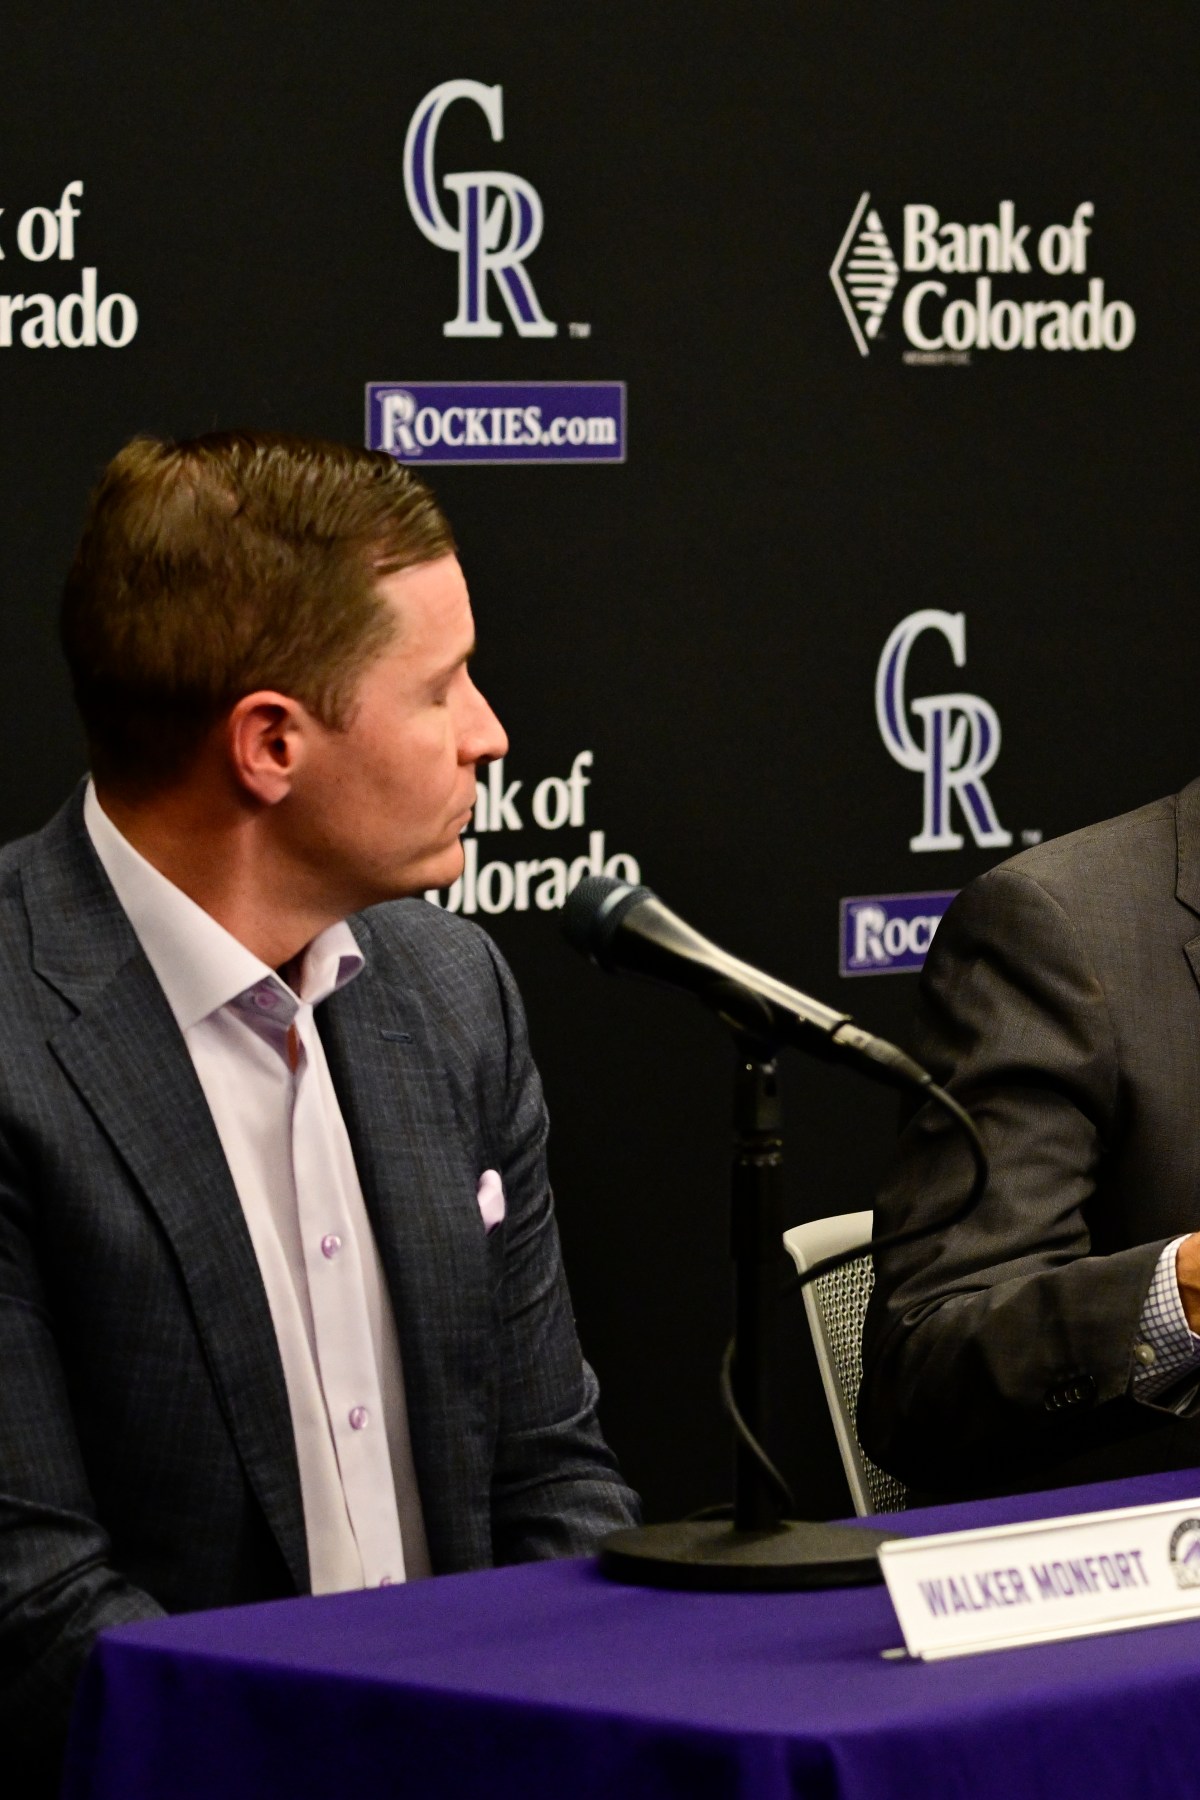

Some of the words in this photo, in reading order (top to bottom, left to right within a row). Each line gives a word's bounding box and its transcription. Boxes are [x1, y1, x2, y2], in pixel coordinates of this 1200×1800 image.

[17, 180, 84, 262] of
[903, 200, 1031, 274] Bank
[1038, 201, 1094, 275] of
[902, 276, 1136, 351] Colorado
[532, 750, 594, 830] of
[918, 1568, 1032, 1618] WALKER
[1030, 1550, 1150, 1600] MONFORT
